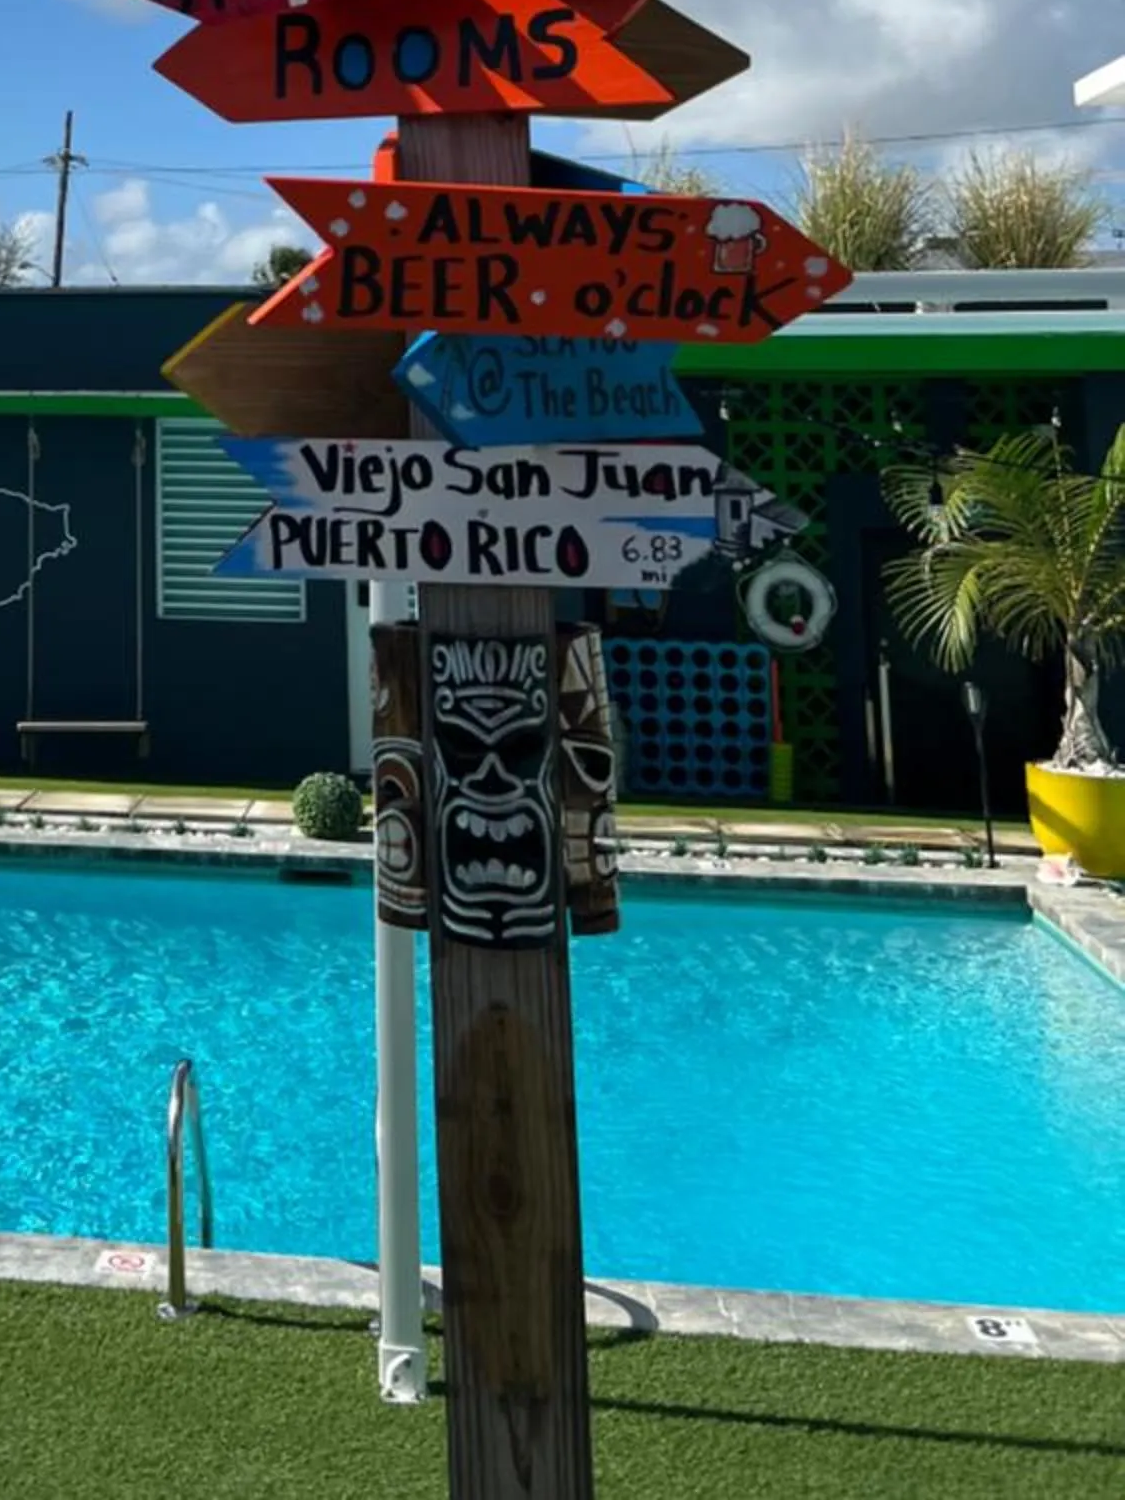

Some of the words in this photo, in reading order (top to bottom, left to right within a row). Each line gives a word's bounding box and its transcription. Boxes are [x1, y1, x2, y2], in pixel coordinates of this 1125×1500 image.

[416, 194, 676, 255] ALWAYS
[336, 245, 522, 324] BEER
[516, 369, 580, 420] The
[586, 366, 681, 421] Beach
[299, 443, 433, 516] Viejo
[443, 448, 551, 500] San
[557, 450, 717, 501] Juan
[271, 513, 453, 572] PUERTO
[467, 520, 591, 579] RICO
[621, 535, 685, 565] 6.83
